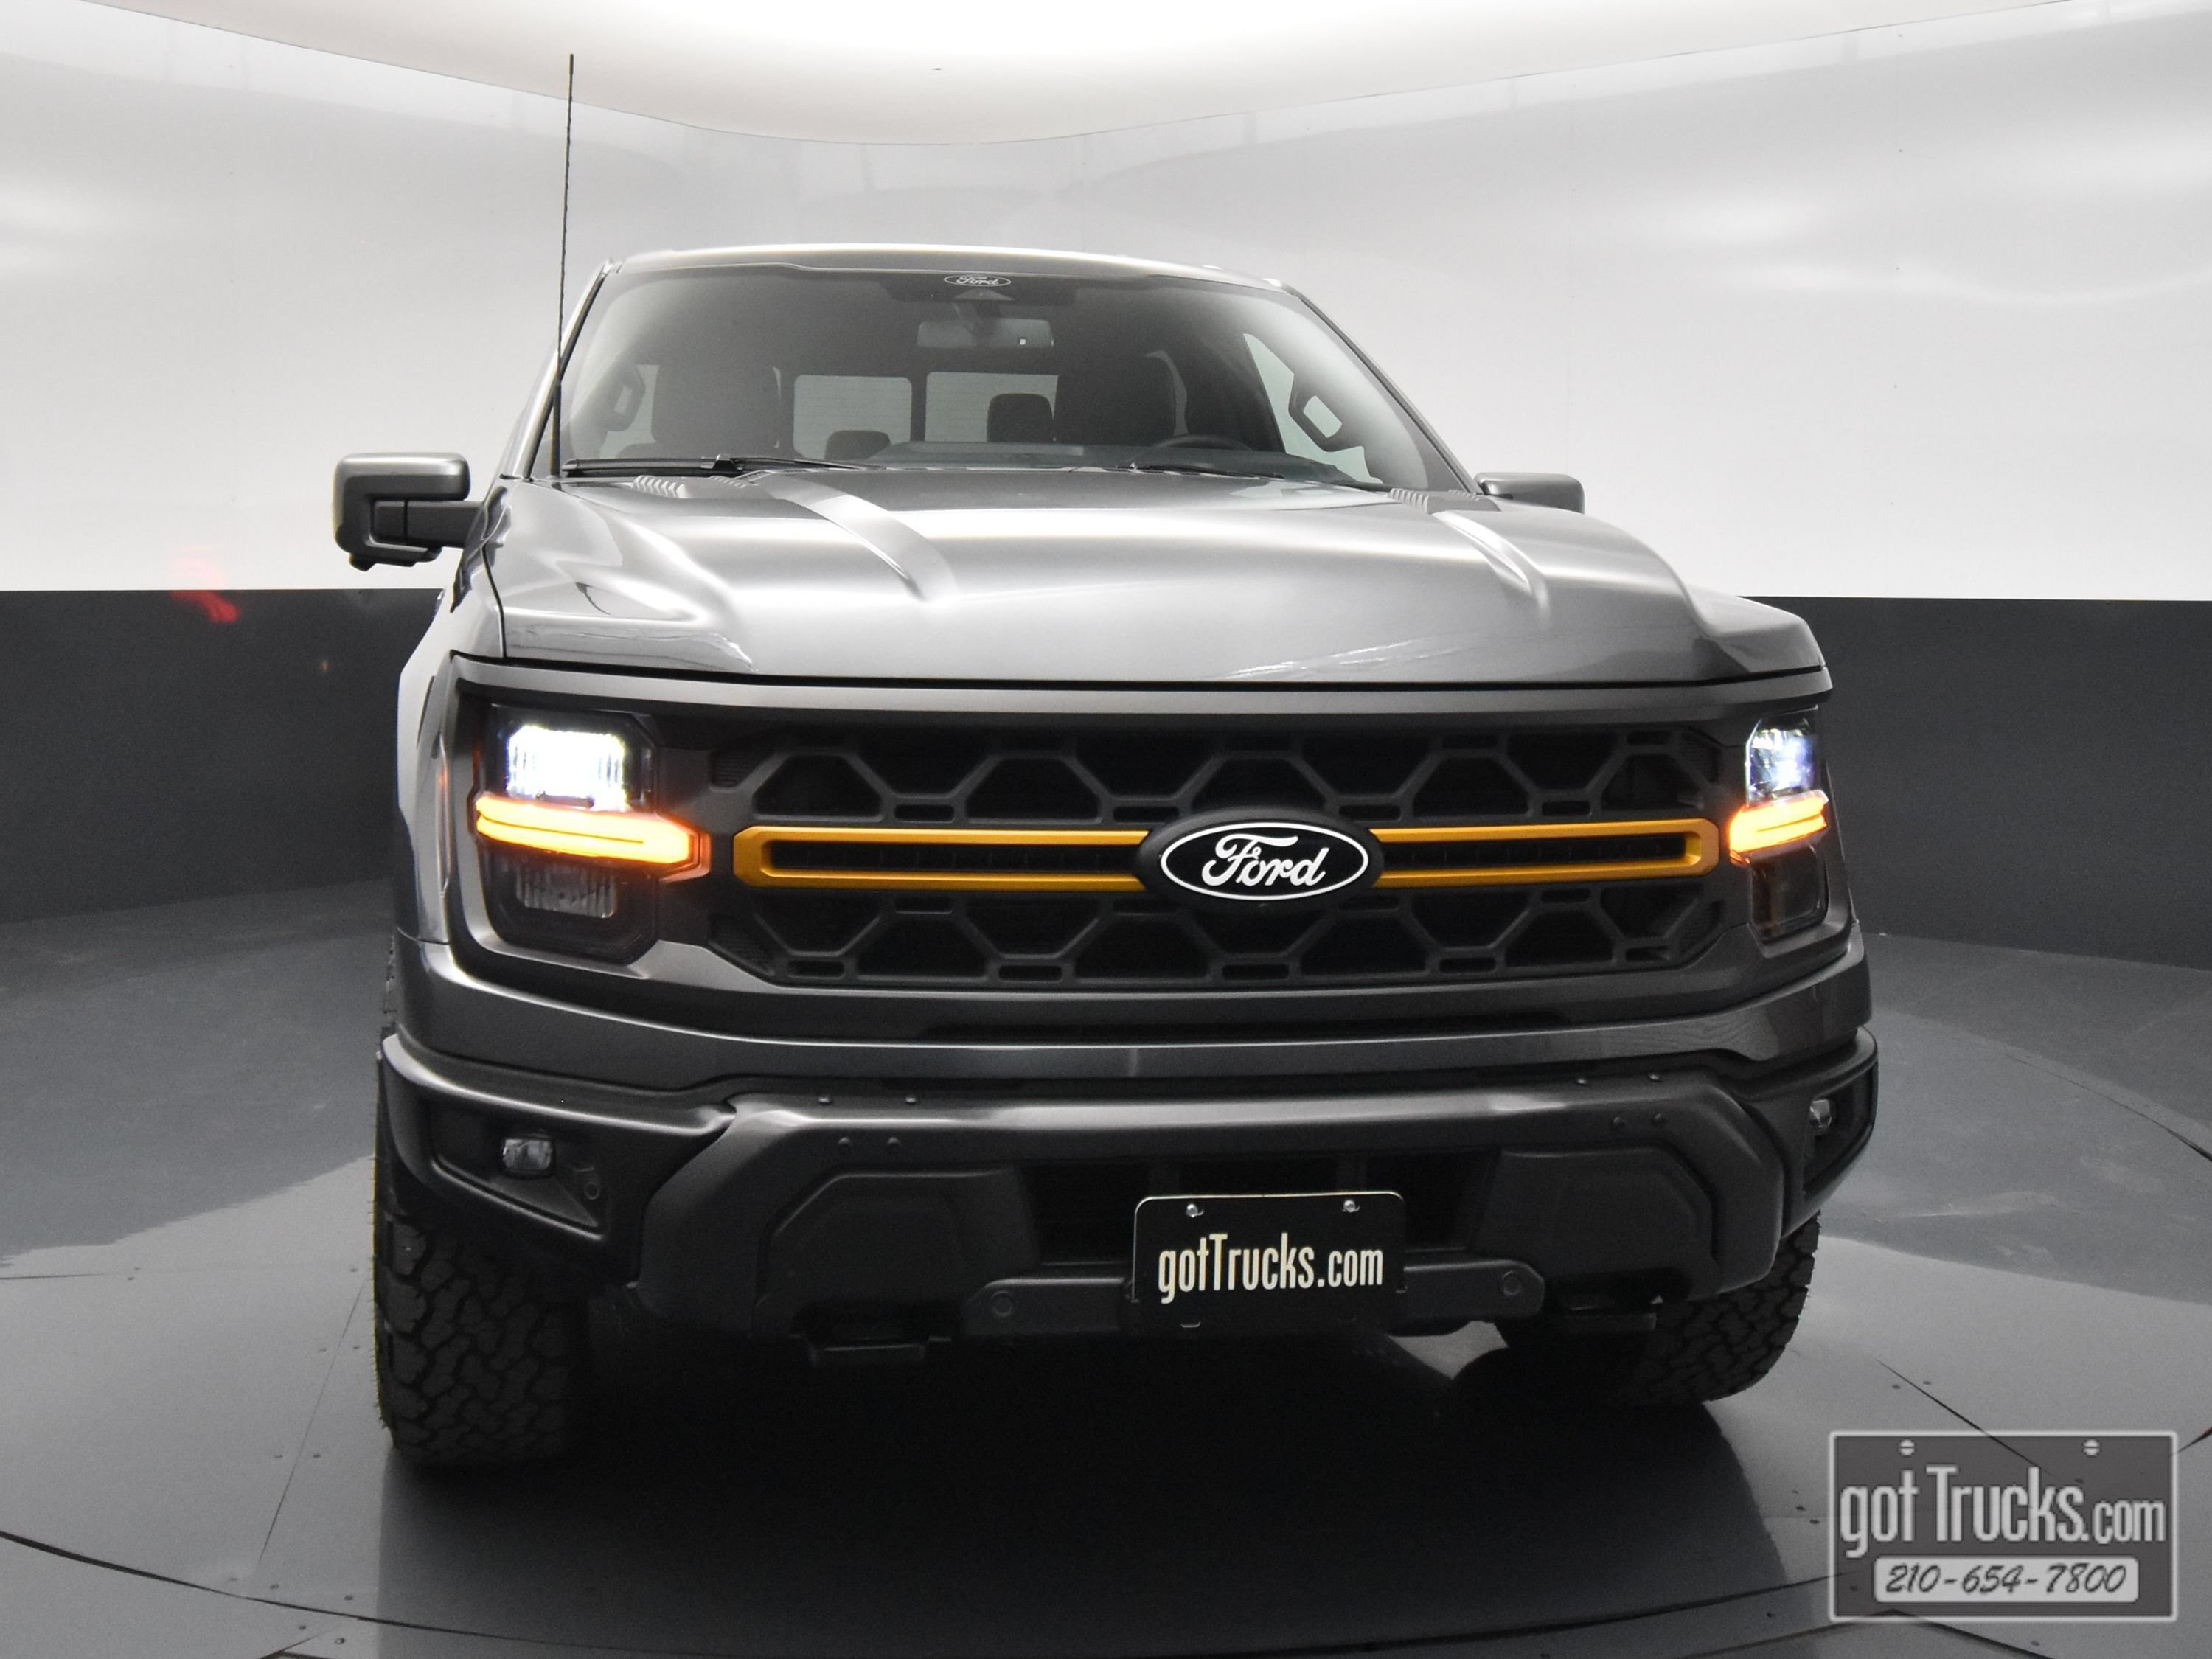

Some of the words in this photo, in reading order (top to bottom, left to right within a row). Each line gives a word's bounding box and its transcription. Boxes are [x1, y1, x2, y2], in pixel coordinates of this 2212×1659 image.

[956, 276, 998, 285] Ford
[1202, 834, 1329, 886] Ford
[1158, 1232, 1383, 1304] gotTrucks.com
